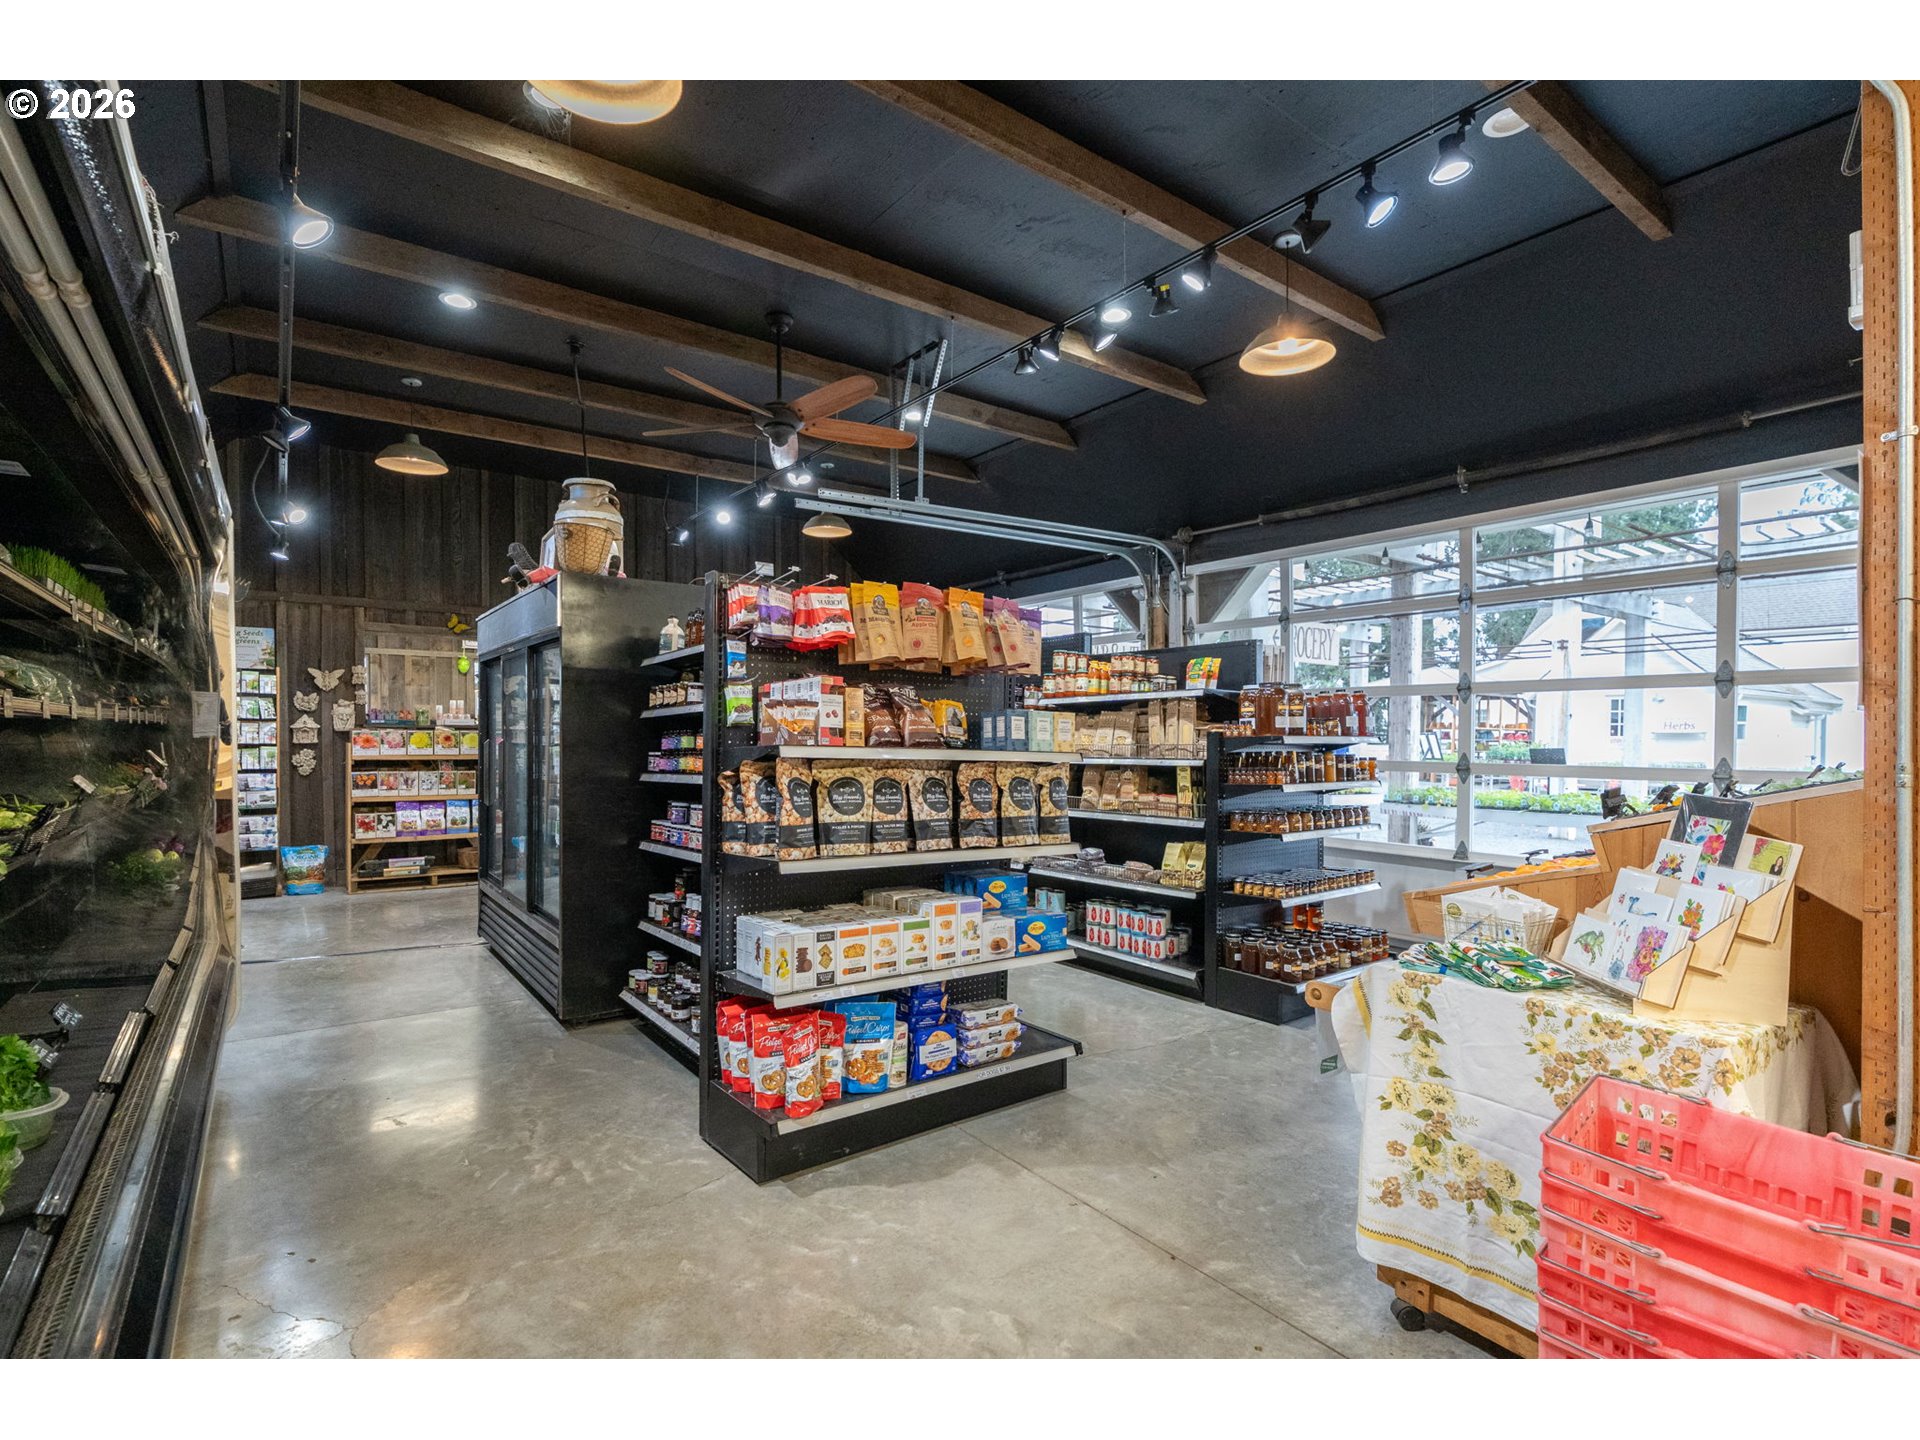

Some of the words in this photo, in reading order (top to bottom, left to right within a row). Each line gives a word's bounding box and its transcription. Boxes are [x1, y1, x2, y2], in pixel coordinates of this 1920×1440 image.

[1663, 721, 1696, 730] Herbs
[867, 1021, 890, 1035] Crisps
[759, 1035, 783, 1051] Pretze
